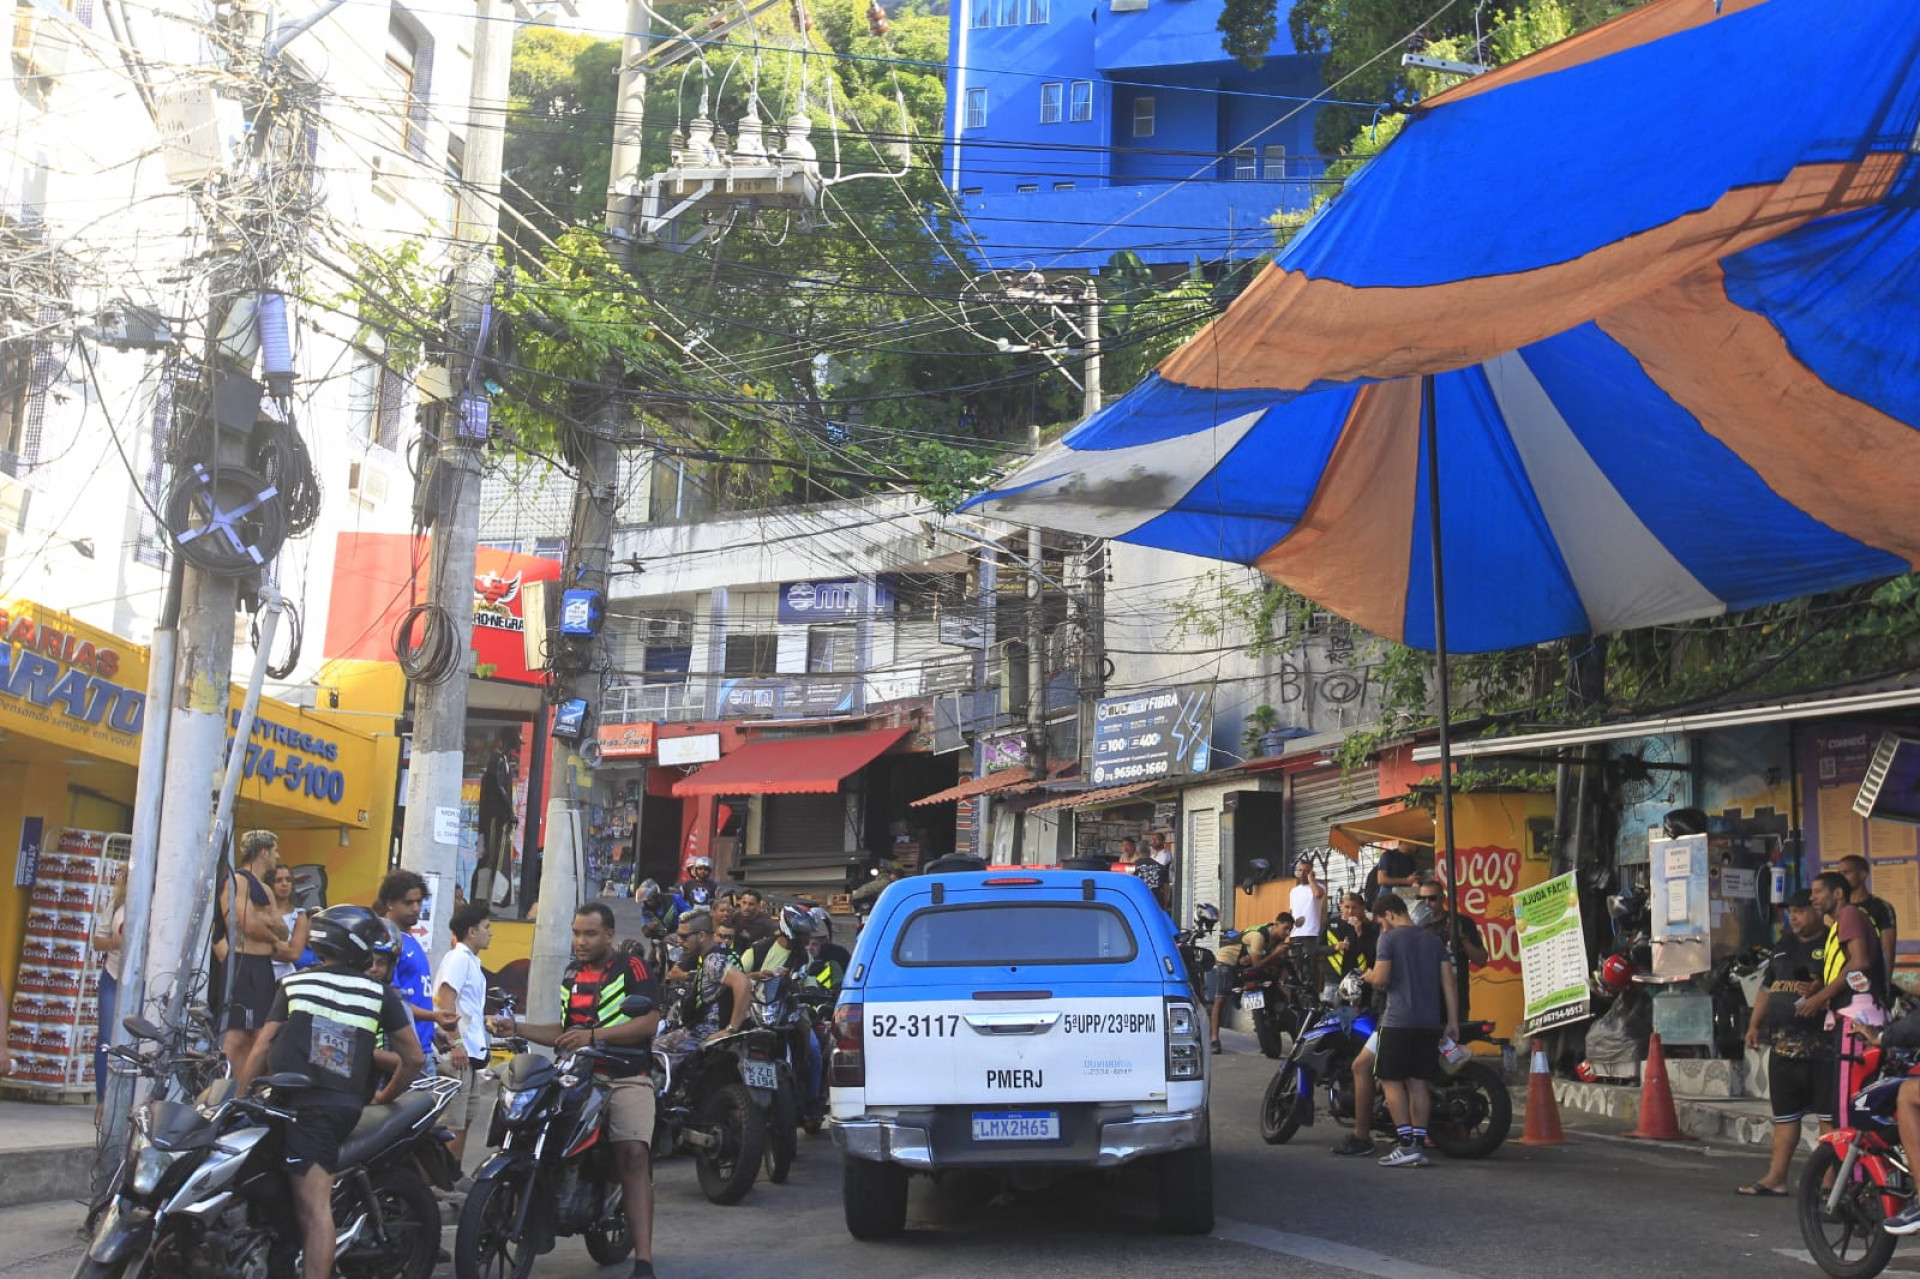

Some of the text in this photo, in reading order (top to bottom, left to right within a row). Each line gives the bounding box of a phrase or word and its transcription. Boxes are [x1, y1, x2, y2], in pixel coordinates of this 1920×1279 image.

[1148, 692, 1178, 710] FIBRA
[1464, 887, 1486, 915] e
[1522, 891, 1547, 908] AJUDA
[872, 1014, 960, 1037] 52-3117
[986, 1070, 1043, 1089] PMERJ
[980, 1119, 1049, 1137] LMX2H65
